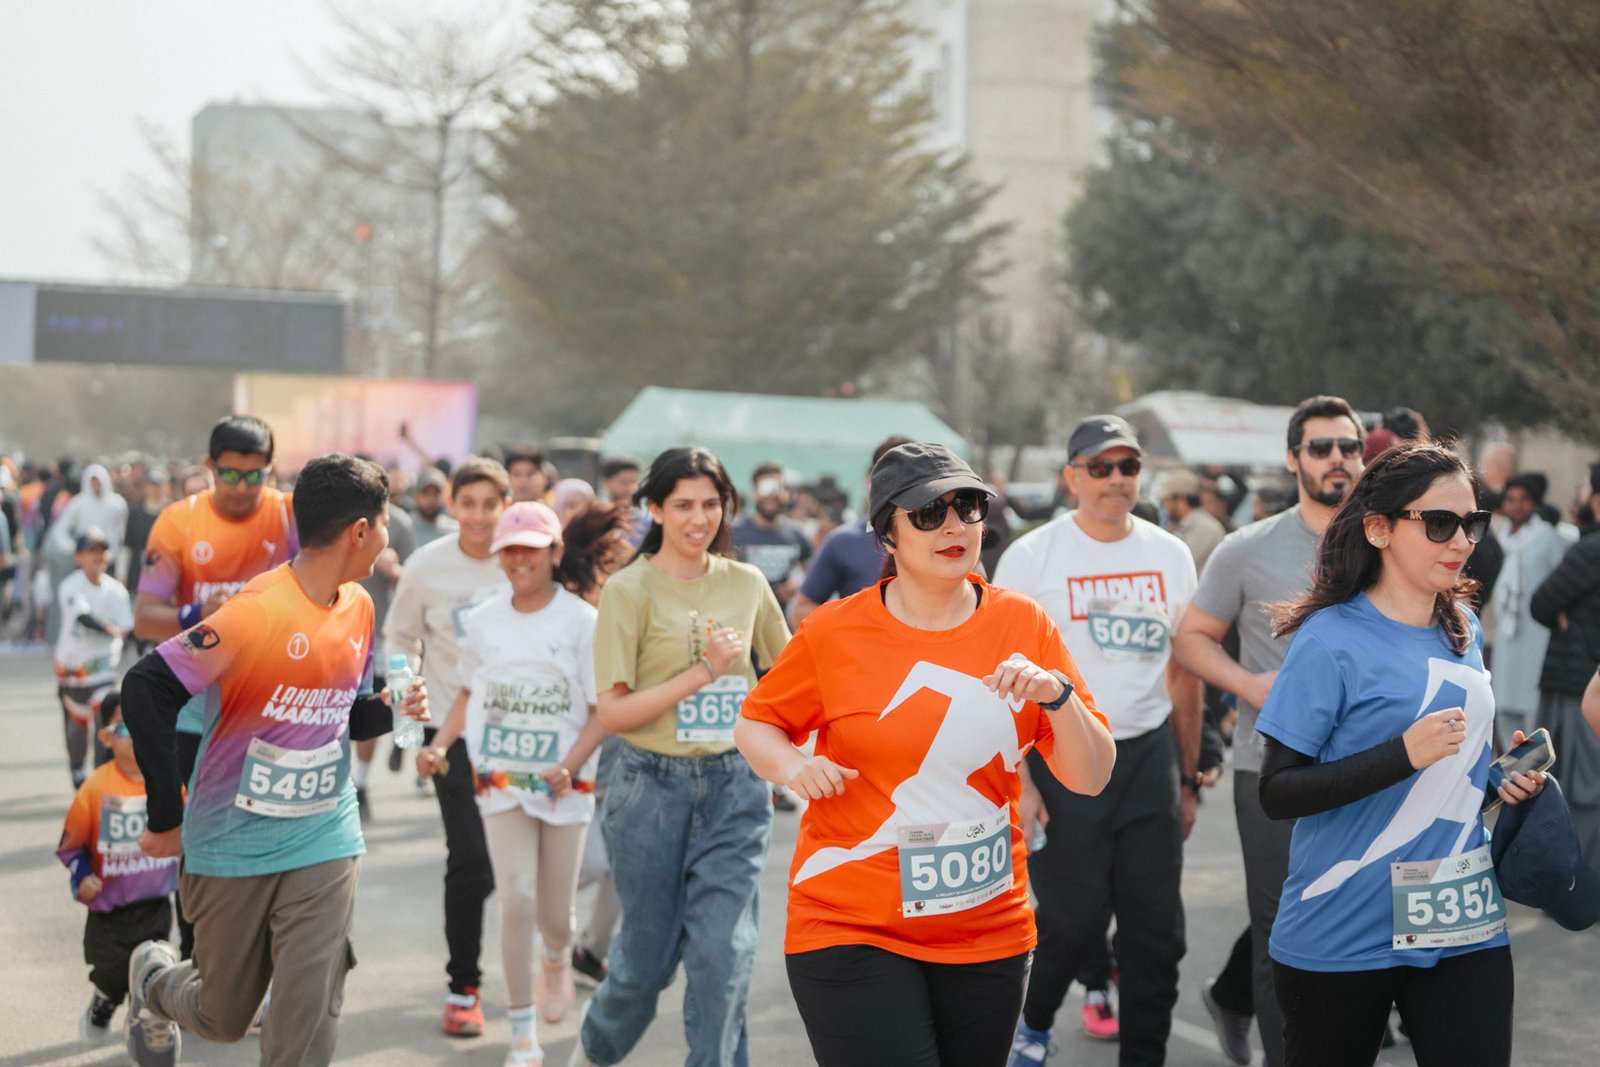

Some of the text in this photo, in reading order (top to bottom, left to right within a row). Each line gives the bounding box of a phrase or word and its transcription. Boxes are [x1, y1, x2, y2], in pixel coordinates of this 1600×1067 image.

[1409, 510, 1423, 520] MK
[1093, 617, 1164, 648] 5042
[270, 683, 333, 708] LAHORE
[488, 728, 553, 759] 5497
[249, 763, 337, 800] 5495
[110, 812, 148, 840] 50
[910, 836, 1007, 891] 5080
[1407, 876, 1499, 925] 5352
